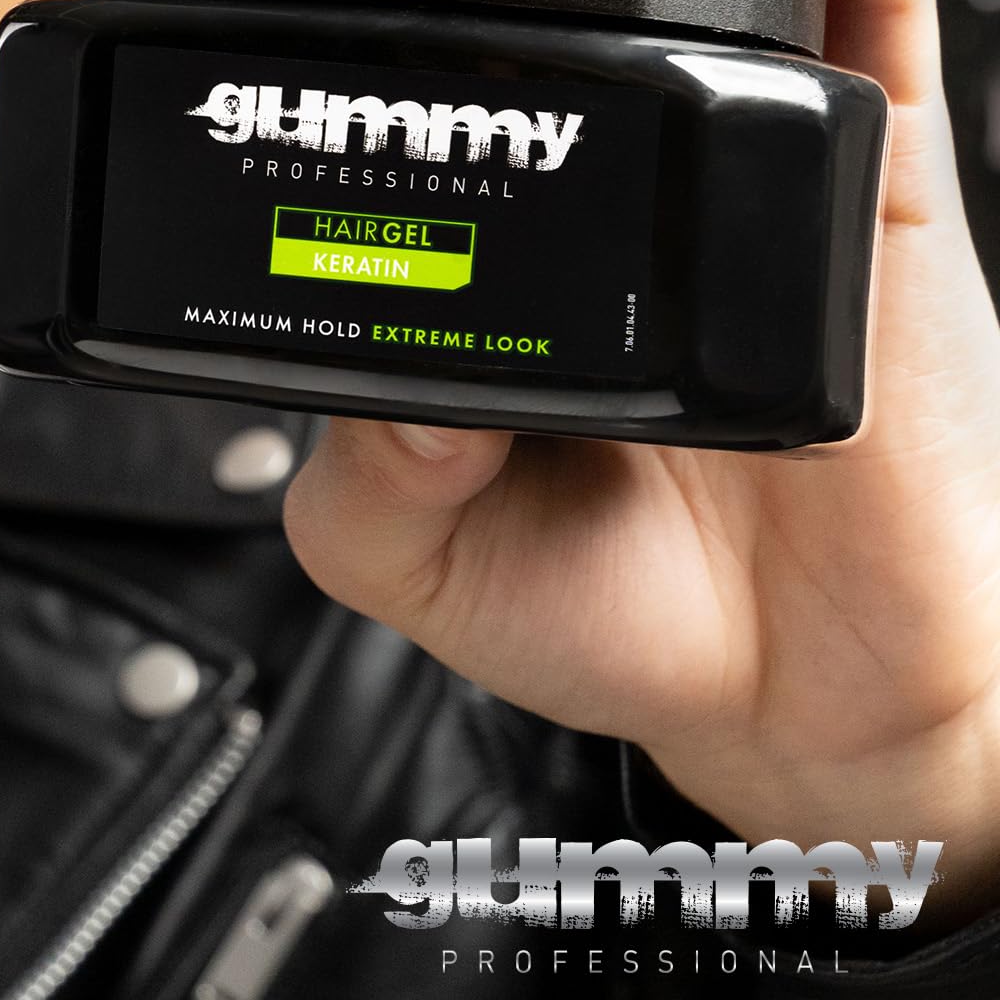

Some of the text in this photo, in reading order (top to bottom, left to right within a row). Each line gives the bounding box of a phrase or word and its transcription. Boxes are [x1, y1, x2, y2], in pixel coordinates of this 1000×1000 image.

[185, 81, 584, 172] gummy
[242, 158, 514, 198] PROFESSIONAL
[313, 252, 410, 280] KERATIN
[184, 306, 550, 356] MAXIMUM HOLD EXTREME LOOK
